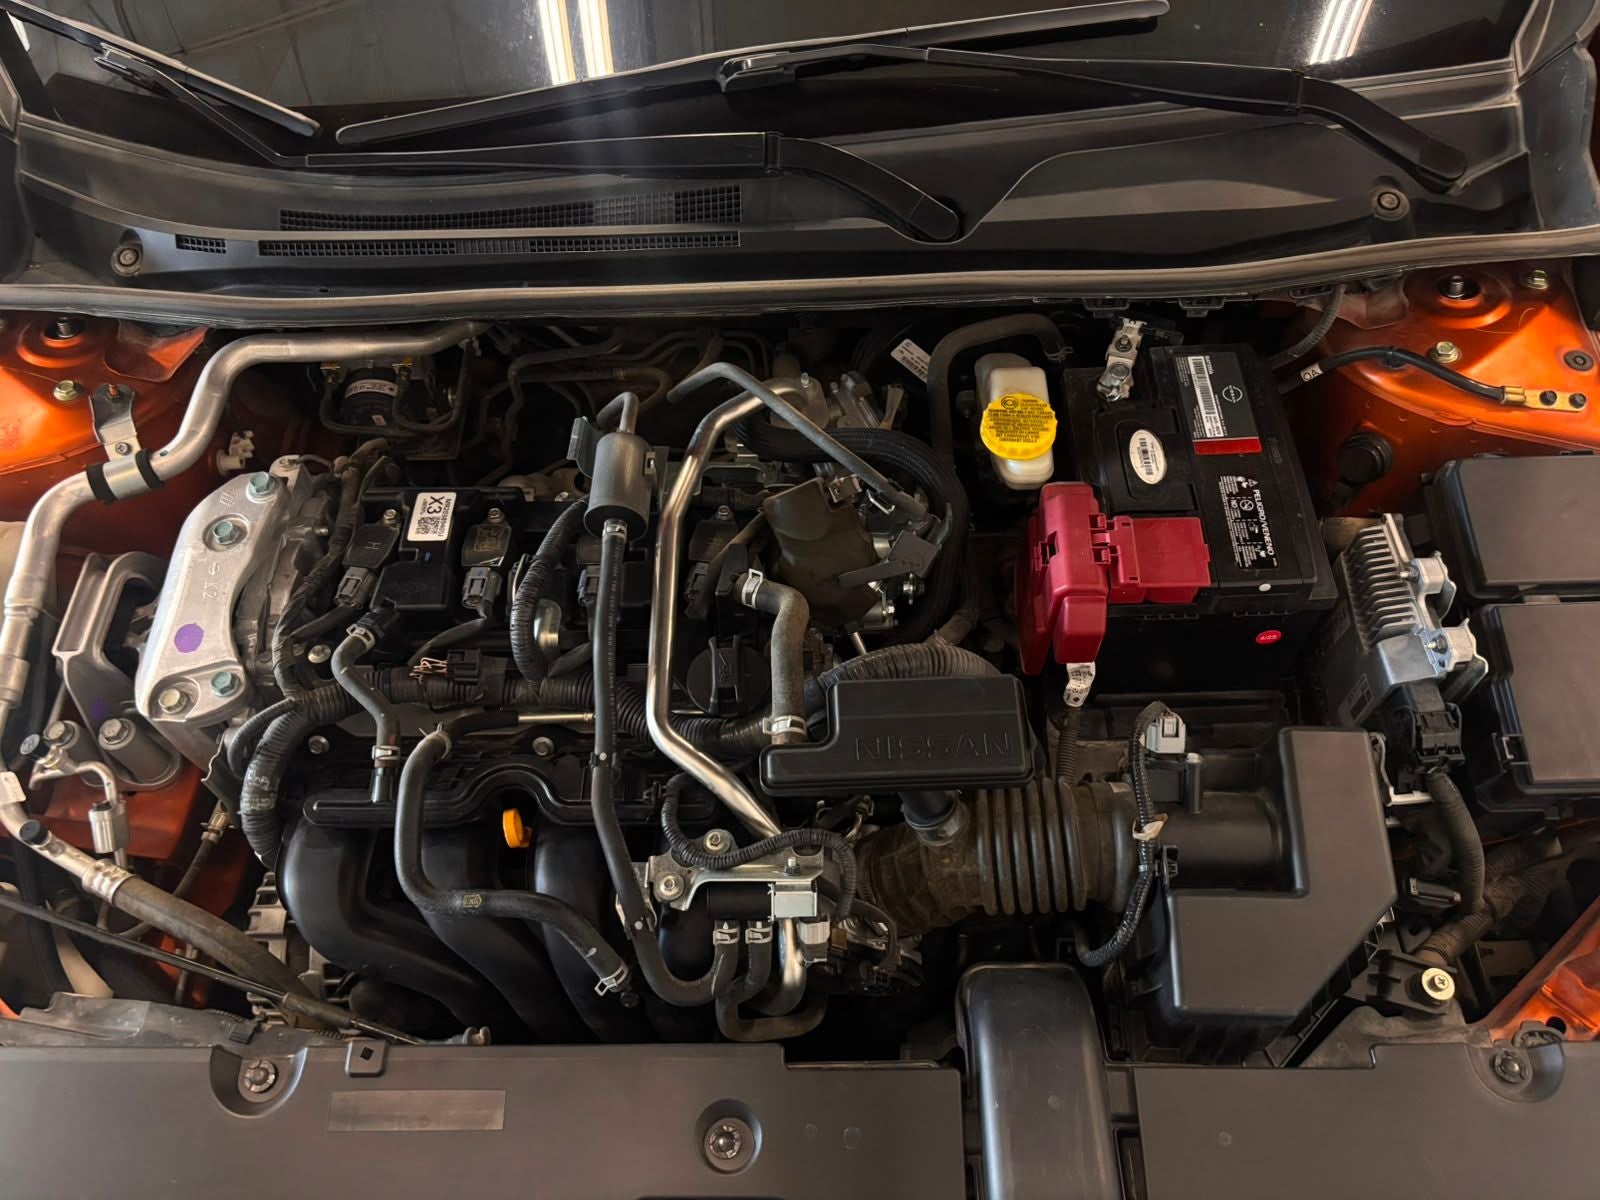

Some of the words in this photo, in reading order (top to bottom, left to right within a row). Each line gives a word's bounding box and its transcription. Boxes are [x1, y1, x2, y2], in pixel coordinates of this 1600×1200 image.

[427, 496, 445, 514] X3
[1230, 500, 1238, 508] NO
[1253, 489, 1275, 555] PELIGRO/VENENO
[855, 732, 1009, 761] NISSAN
